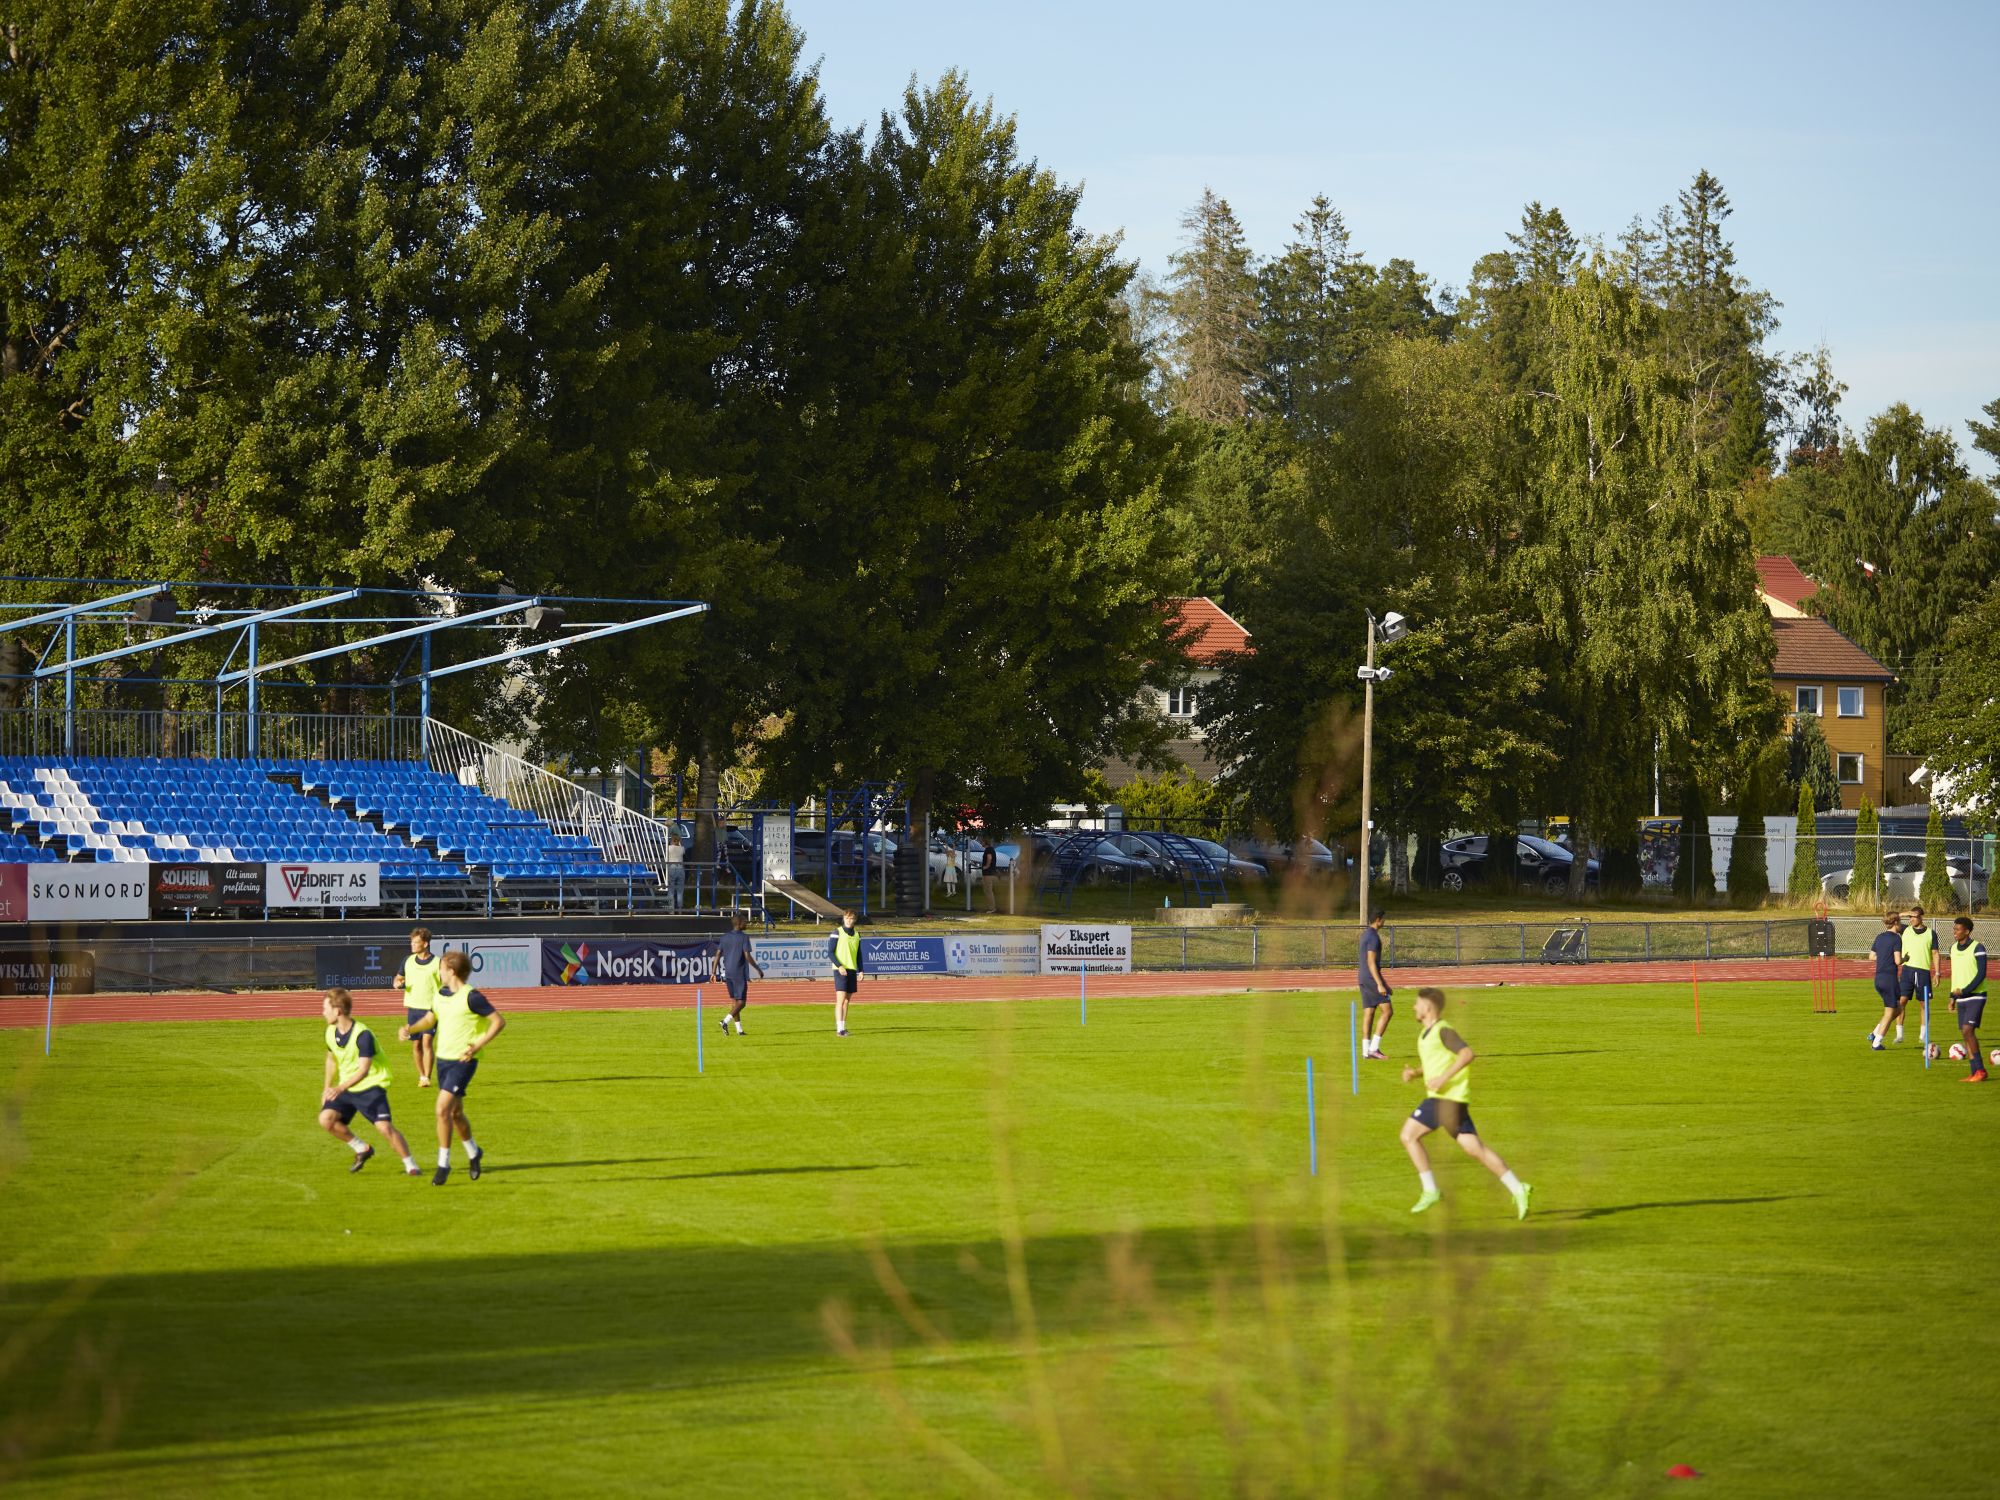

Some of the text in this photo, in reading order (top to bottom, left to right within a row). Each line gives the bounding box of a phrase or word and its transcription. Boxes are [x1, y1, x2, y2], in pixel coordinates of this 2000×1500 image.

[162, 869, 210, 887] SOLHEIM
[226, 869, 257, 879] Alt innen
[290, 873, 366, 887] VEIDRIFT AS
[223, 882, 260, 894] profilering
[332, 893, 367, 902] roadworks
[1069, 929, 1110, 943] Ekspert
[886, 940, 917, 950] EKSPERT
[969, 944, 980, 954] Ski
[1047, 943, 1126, 955] Maskinutleie as
[755, 950, 789, 961] FOLLO
[868, 951, 930, 961] MASKINUTLEIE AS
[596, 949, 656, 978] Norsk
[82, 967, 92, 977] AS
[326, 974, 393, 986] EIE eiendomsm
